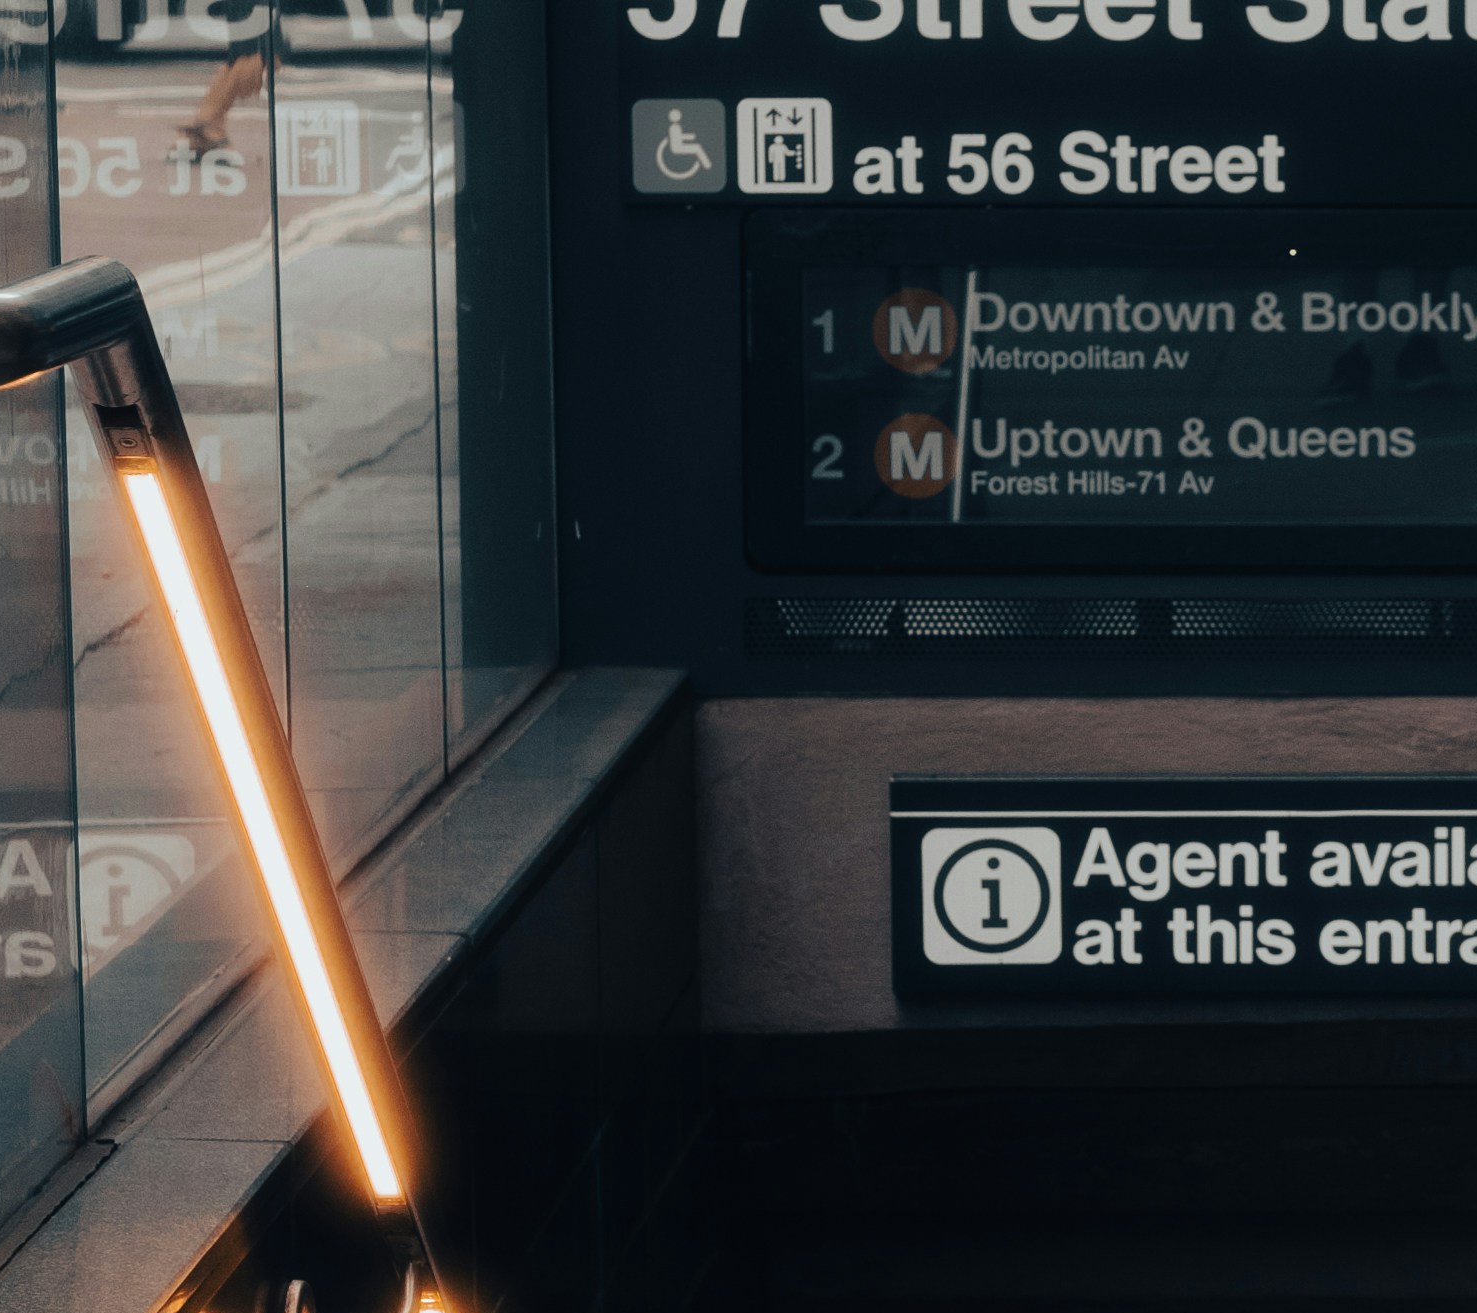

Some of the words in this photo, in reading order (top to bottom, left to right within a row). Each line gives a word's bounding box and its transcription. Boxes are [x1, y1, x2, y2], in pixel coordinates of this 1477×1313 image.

[852, 133, 924, 195] at
[945, 133, 1037, 195] 56
[1057, 130, 1287, 195] Street
[811, 308, 834, 353] 1
[888, 304, 943, 355] M
[973, 291, 1236, 333] Downtown
[1250, 290, 1287, 333] &
[970, 344, 1145, 375] Metropolitan
[1152, 345, 1190, 370] Av
[811, 435, 845, 479] 2
[889, 430, 944, 481] M
[971, 417, 1163, 468] Uptown
[1177, 416, 1214, 459] &
[1227, 416, 1417, 460] Queens
[970, 470, 1059, 496] Forest
[1067, 470, 1167, 496] Hills-71
[1178, 470, 1216, 496] Av
[1073, 826, 1287, 902] Agent
[1073, 907, 1142, 965] at
[1167, 904, 1296, 965] this
